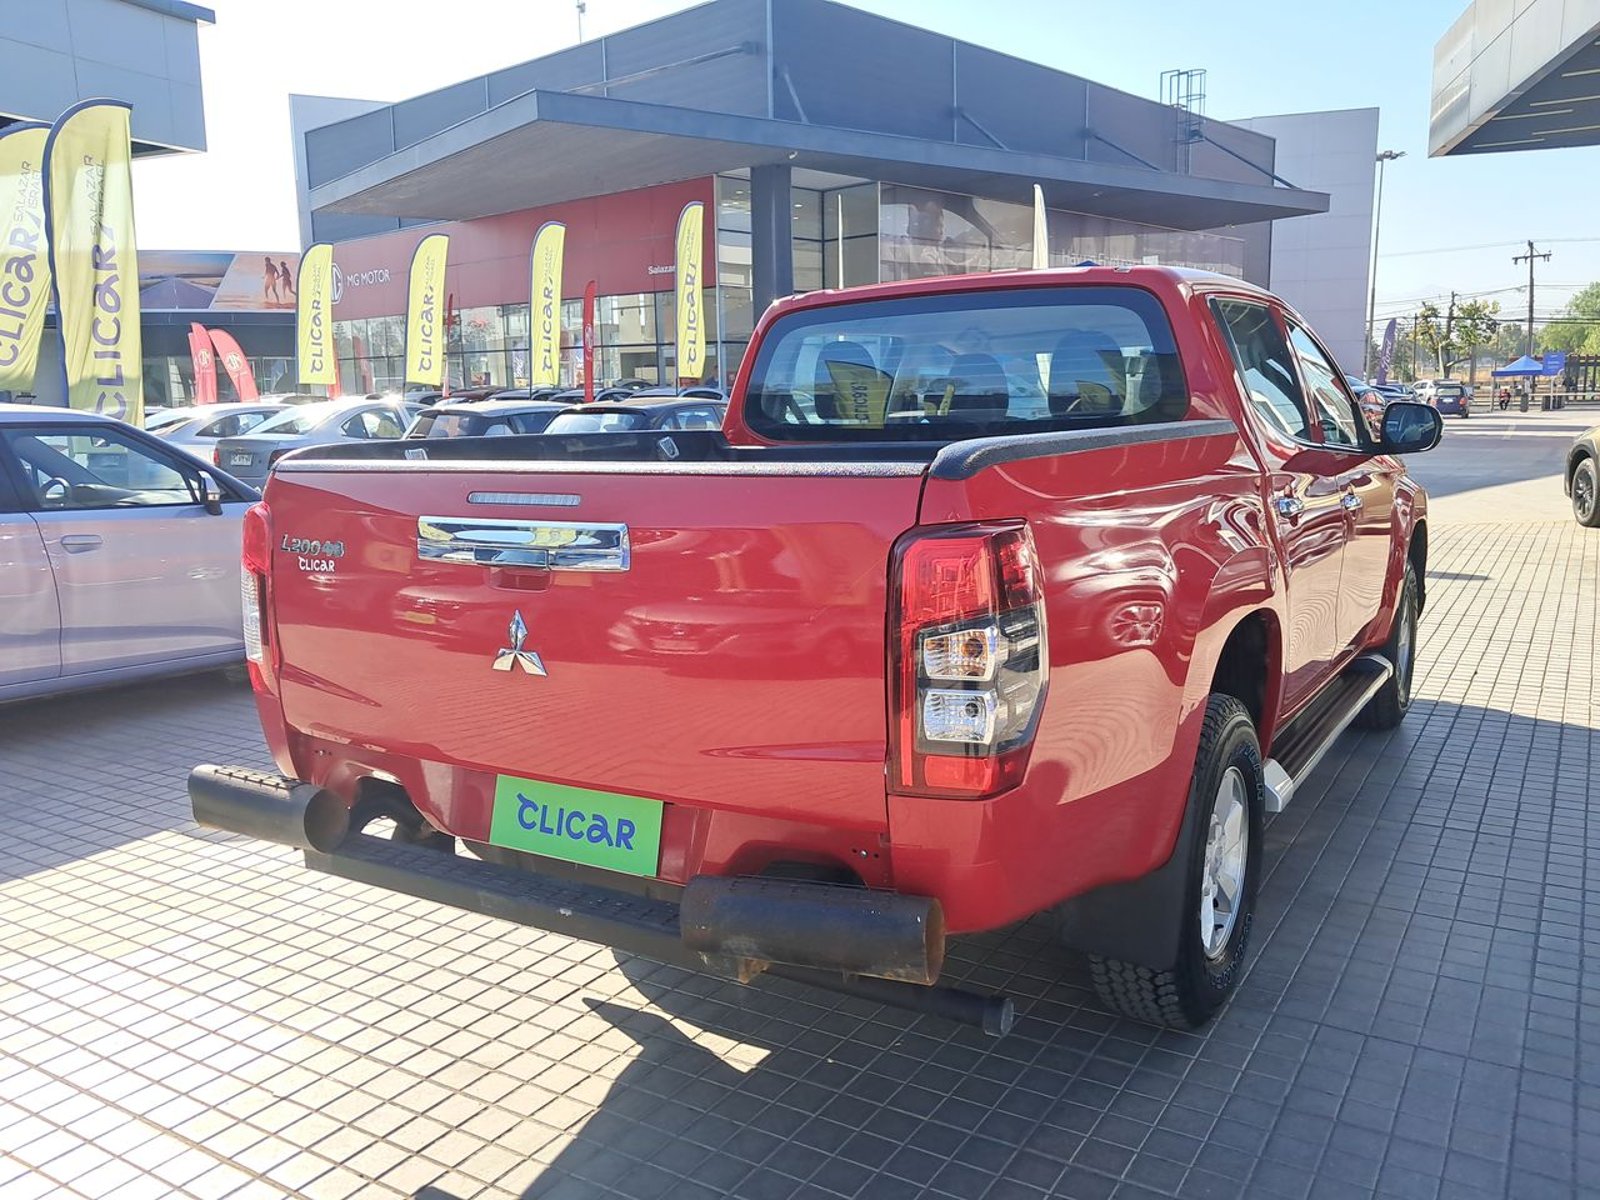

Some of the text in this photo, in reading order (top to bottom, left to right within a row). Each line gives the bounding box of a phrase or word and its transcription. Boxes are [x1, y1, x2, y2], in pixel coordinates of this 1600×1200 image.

[84, 154, 99, 235] SALAZAR
[347, 269, 390, 287] MG MOTOR
[310, 299, 324, 373] CLICAR
[418, 294, 434, 373] CLICAR
[542, 287, 553, 373] CLICAR
[281, 533, 321, 556] L200
[297, 556, 336, 572] CLICAR
[516, 793, 636, 850] CLICAR
